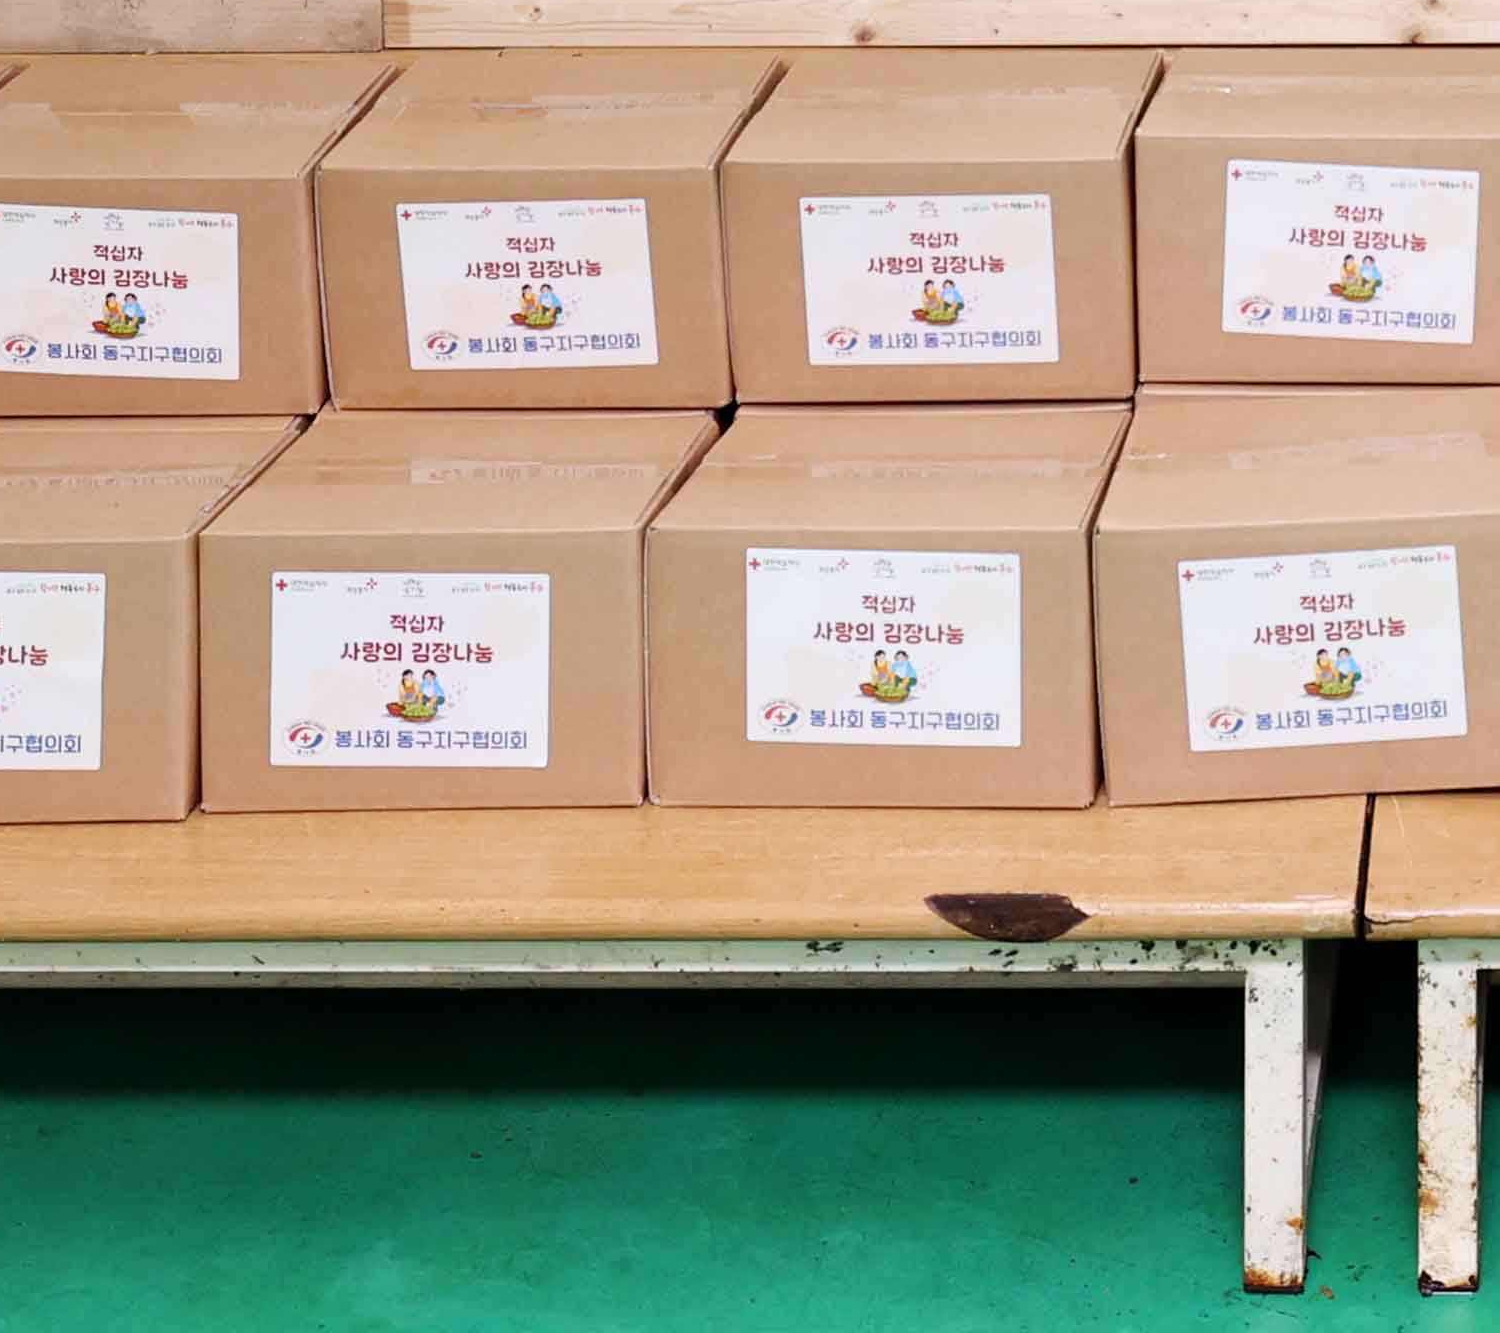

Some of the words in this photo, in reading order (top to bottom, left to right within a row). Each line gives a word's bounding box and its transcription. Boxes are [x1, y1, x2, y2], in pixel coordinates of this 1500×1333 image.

[1332, 204, 1385, 224] 적십자
[504, 235, 557, 254] 적십자
[1287, 226, 1345, 249] 사랑의
[1351, 229, 1428, 253] 김장나눔
[462, 260, 521, 281] 사랑의
[526, 258, 604, 279] 김장나눔
[1280, 304, 1332, 325] 봉사회
[1336, 307, 1457, 331] 동구지구협의회
[466, 336, 518, 355] 봉사회
[521, 332, 641, 353] 동구지구협의회
[860, 594, 917, 615] 적십자
[812, 620, 875, 644] 사랑의
[882, 622, 965, 645] 김장나눔
[808, 708, 864, 729] 봉사회
[869, 709, 1000, 732] 동구지구협의회
